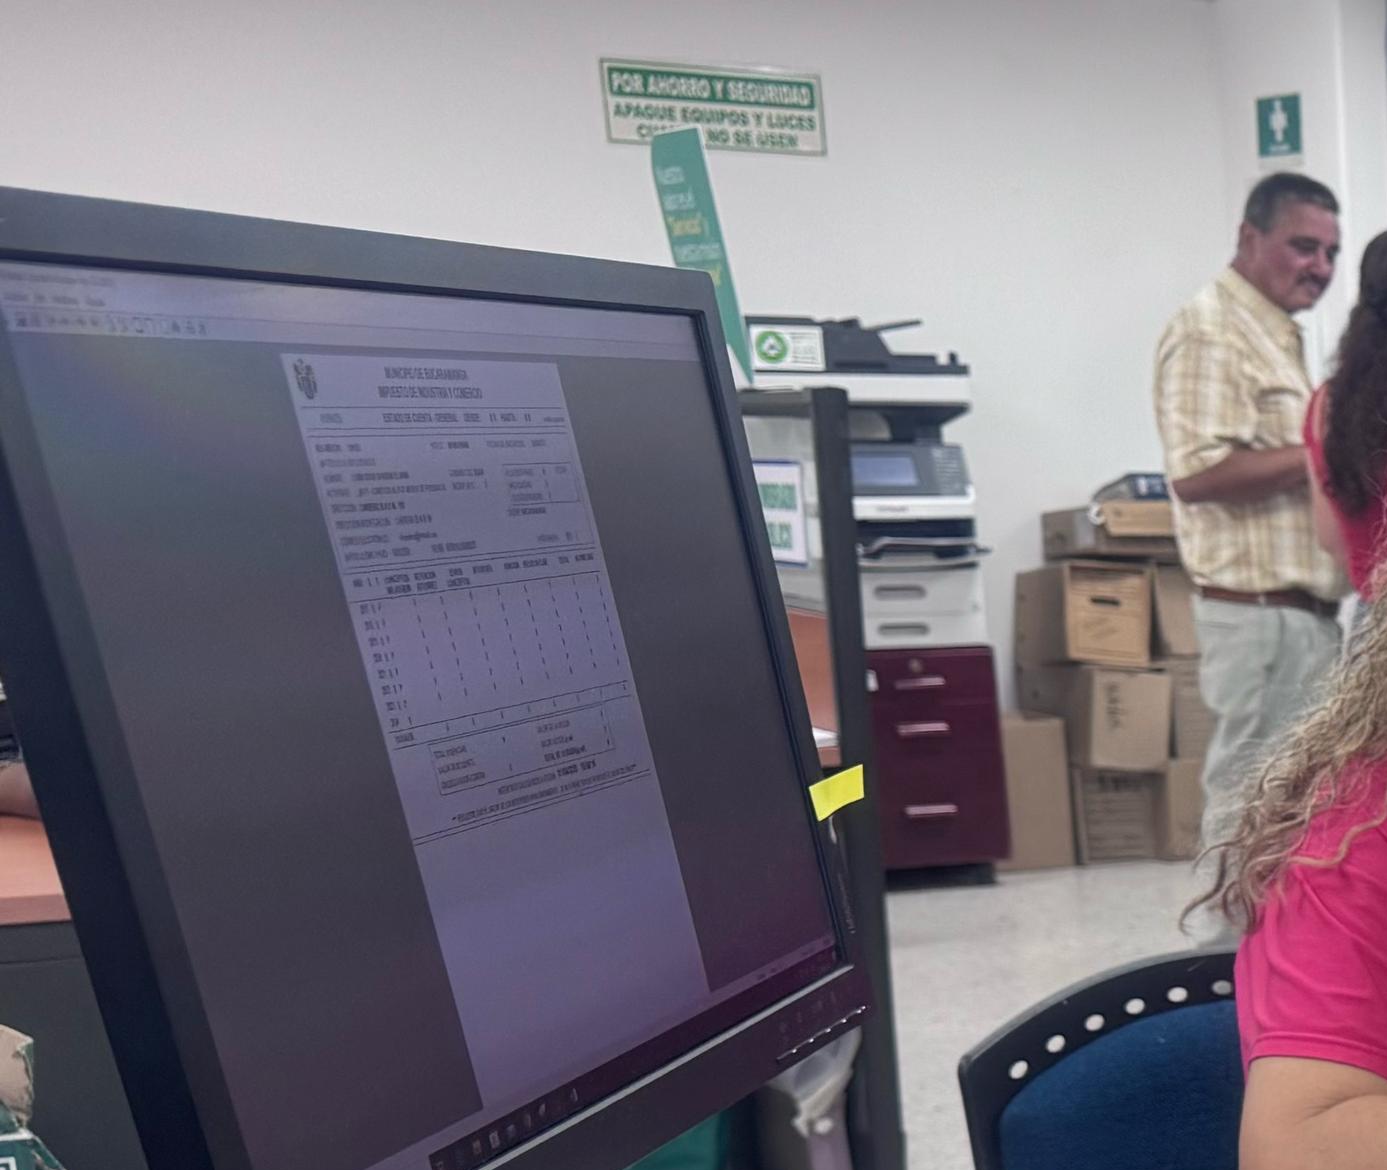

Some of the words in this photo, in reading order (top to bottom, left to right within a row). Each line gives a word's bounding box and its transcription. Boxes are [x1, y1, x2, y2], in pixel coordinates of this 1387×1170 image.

[610, 71, 644, 93] POR
[649, 76, 711, 99] AHORRO
[712, 80, 724, 100] Y
[727, 80, 812, 106] SEGURIDAD
[613, 102, 677, 121] APAGUE
[680, 106, 750, 127] EQUIPOS
[752, 112, 764, 128] Y
[766, 113, 817, 131] LUCES
[706, 129, 729, 144] NO
[734, 132, 752, 145] SE
[756, 133, 798, 148] USEN
